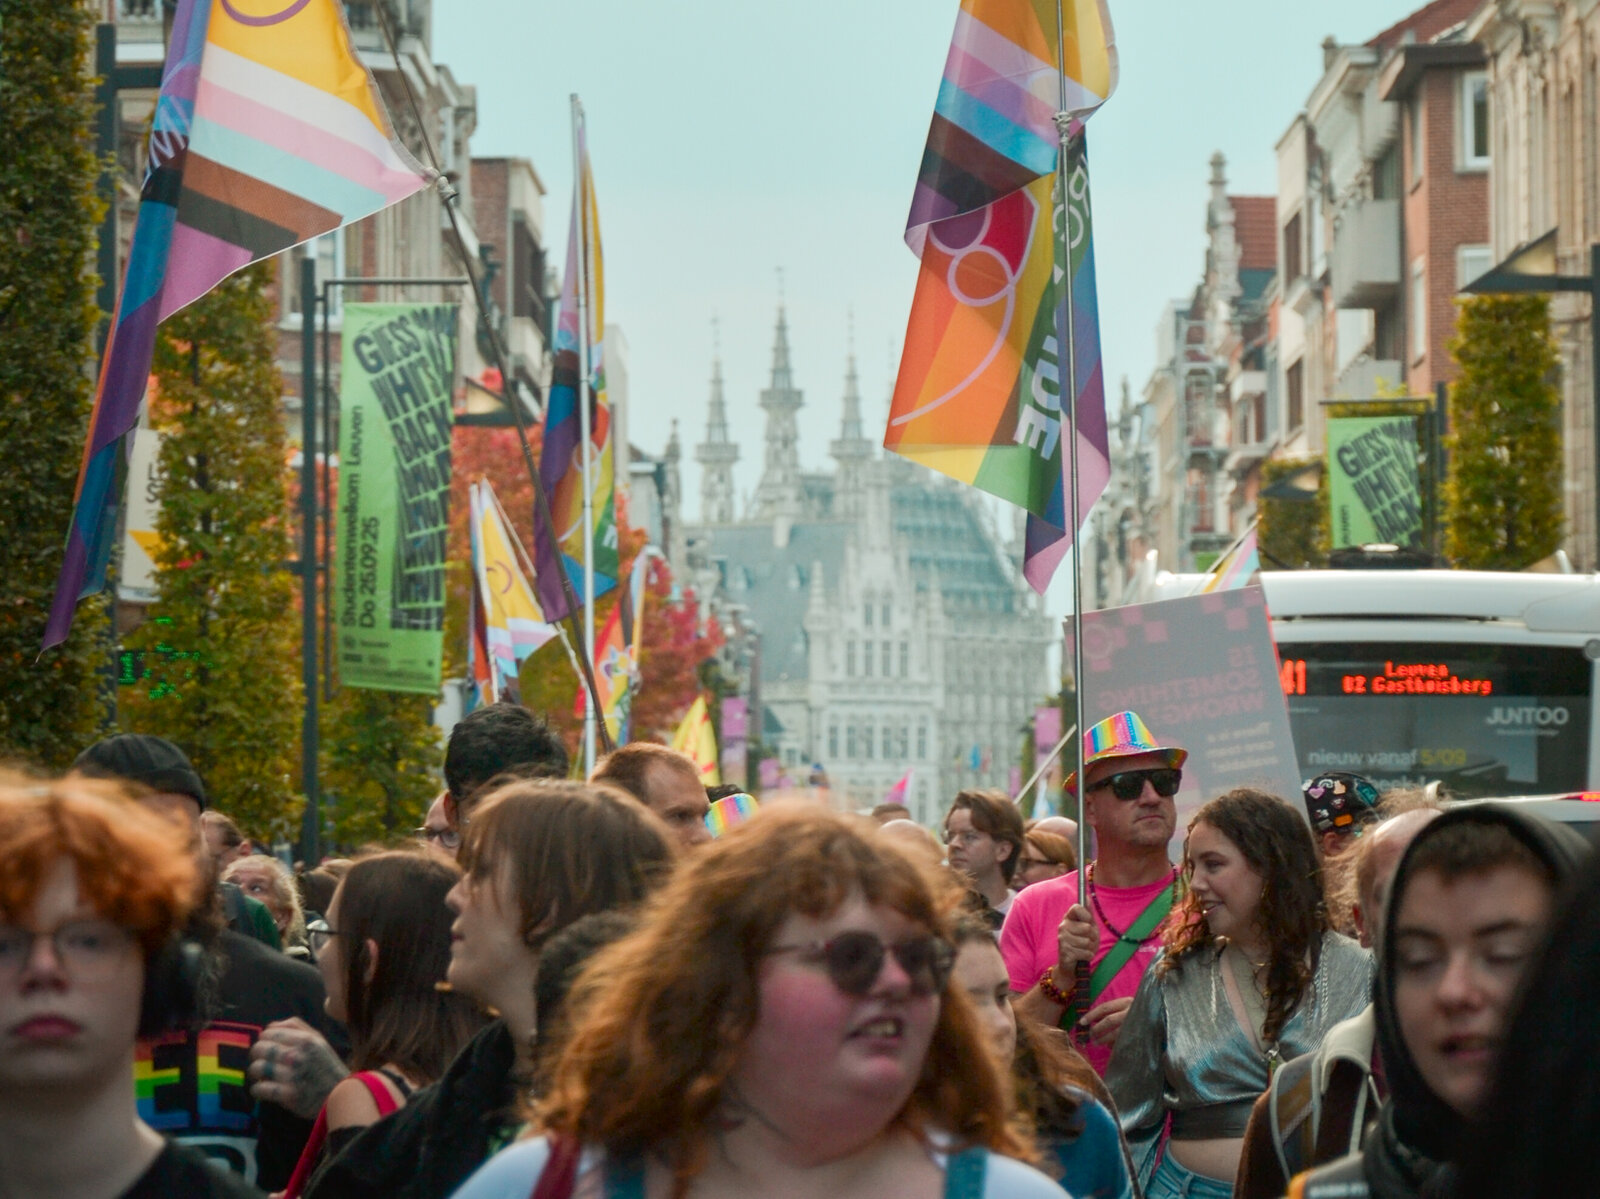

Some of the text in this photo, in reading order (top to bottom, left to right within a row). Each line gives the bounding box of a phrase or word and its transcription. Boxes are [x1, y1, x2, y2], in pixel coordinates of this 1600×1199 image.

[390, 401, 452, 468] BACK
[341, 405, 363, 627] Studentenwelkom Leuven
[360, 516, 380, 596] 25.09.25
[359, 600, 377, 628] Do
[1385, 660, 1449, 678] Leuven
[1371, 675, 1493, 696] Gasthuisberg
[1486, 707, 1569, 725] JUNTOO
[1308, 749, 1363, 765] nieuw
[1367, 748, 1418, 765] vanaf
